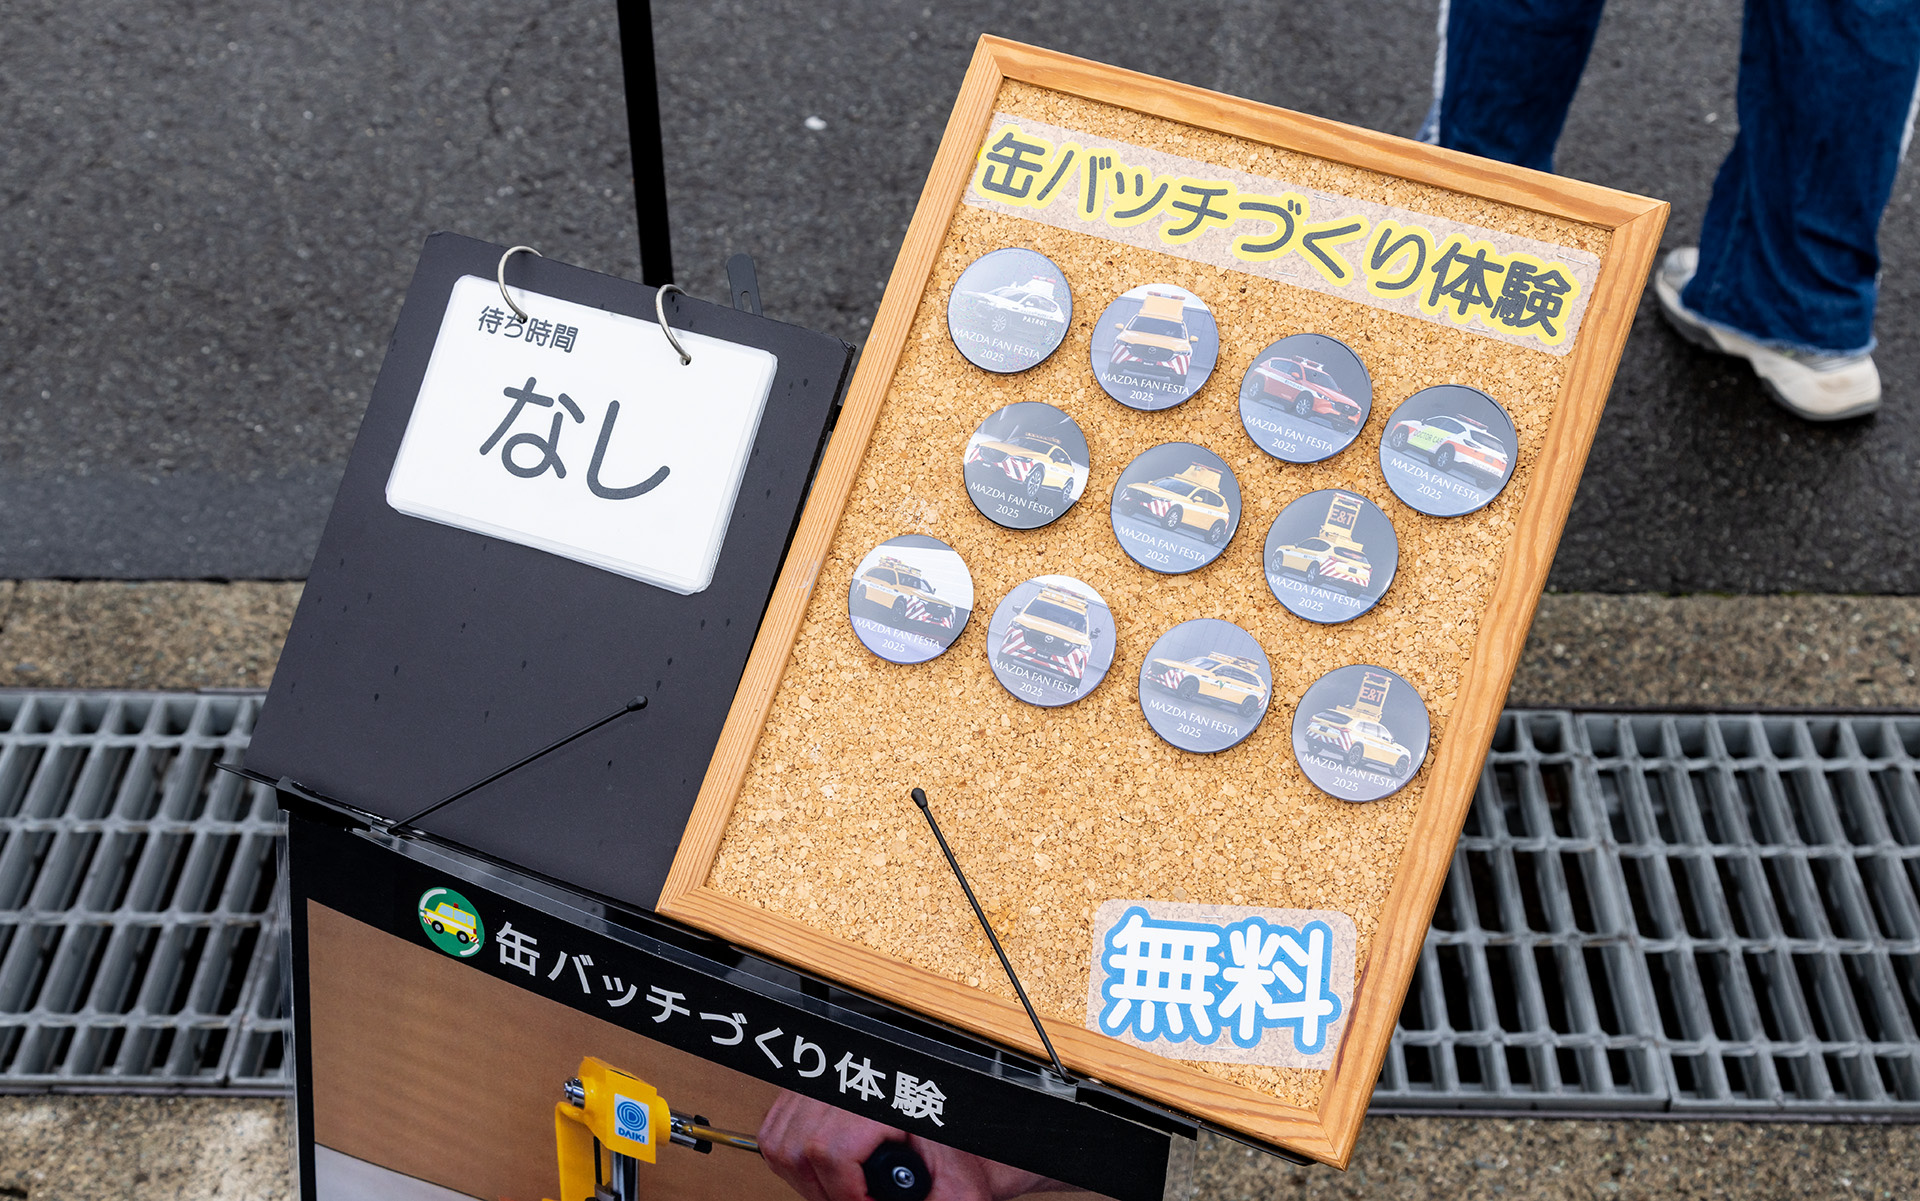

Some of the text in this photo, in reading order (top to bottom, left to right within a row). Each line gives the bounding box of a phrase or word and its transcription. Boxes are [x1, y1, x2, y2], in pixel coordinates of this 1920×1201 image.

[983, 131, 1572, 338] 缶バッチづくり体験
[477, 305, 578, 353] 待ち時間
[952, 327, 1040, 359] MAZDA FAN FESTA
[980, 349, 1004, 363] 2025
[1101, 373, 1190, 397] MAZDA FAN FESTA
[1130, 390, 1154, 403] 2025
[479, 376, 671, 500] なし
[1245, 415, 1333, 452] MAZDA FAN FESTA
[1271, 438, 1296, 453] 2025
[1390, 458, 1480, 502] MAZDA FAN FESTA
[1417, 483, 1443, 500] 2025
[970, 482, 1054, 517] MAZDA FAN FESTA
[995, 504, 1019, 519] 2025
[1330, 509, 1355, 526] E&T
[1118, 526, 1206, 563] MAZDA FAN FESTA
[1145, 549, 1169, 564] 2025
[1269, 575, 1361, 609] MAZDA FAN FESTA
[1298, 597, 1324, 612] 2025
[855, 618, 940, 650] MAZDA FAN FESTA
[882, 638, 905, 653] 2025
[993, 660, 1080, 696] MAZDA FAN FESTA
[1019, 682, 1043, 697] 2025
[1360, 686, 1386, 702] E&T
[1149, 699, 1239, 737] MAZDA FAN FESTA
[1176, 723, 1202, 739] 2025
[1303, 753, 1398, 790] MAZDA FAN FESTA
[1332, 776, 1359, 792] 2025
[1103, 910, 1338, 1050] 無料
[495, 921, 948, 1127] 缶バッチづくり体験
[618, 1127, 645, 1144] DAIKI
